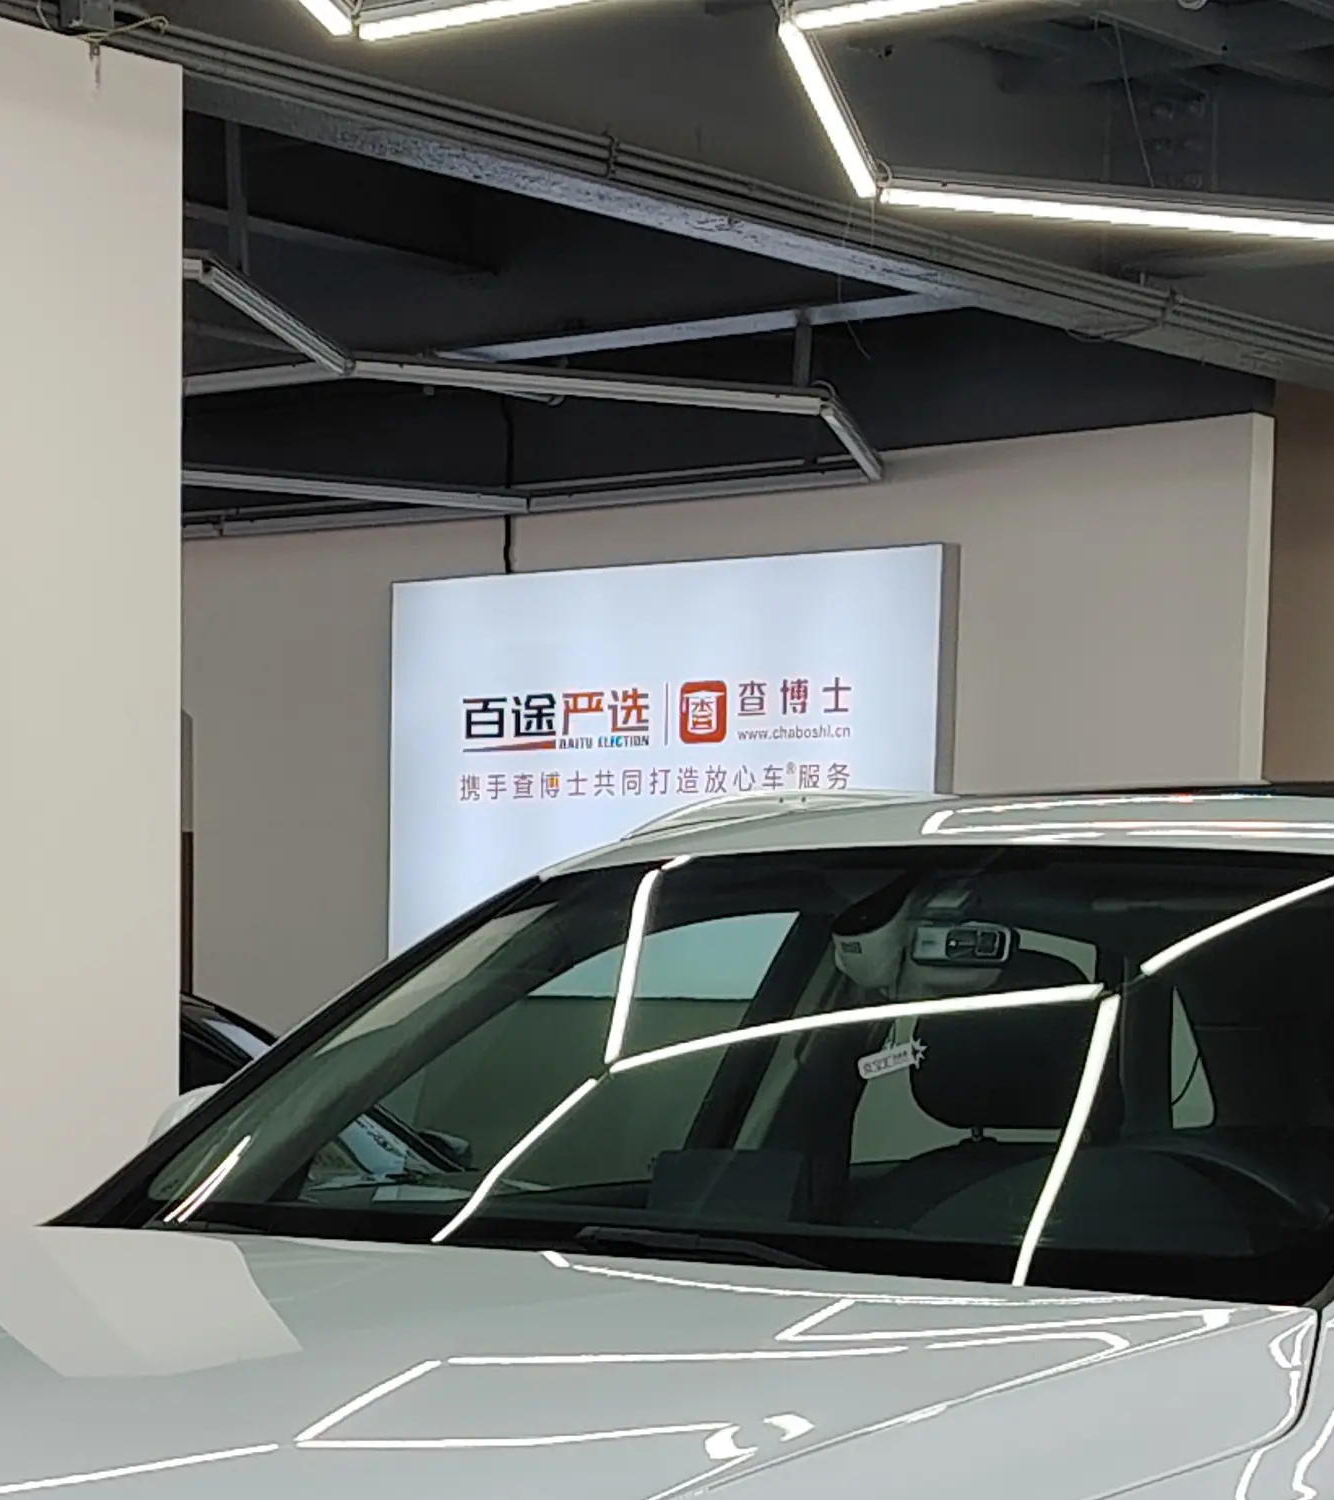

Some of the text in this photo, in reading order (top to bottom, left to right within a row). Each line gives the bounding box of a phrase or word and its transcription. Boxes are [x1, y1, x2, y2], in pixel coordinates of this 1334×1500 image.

[463, 687, 650, 739] 百途严选
[737, 676, 852, 717] 查博士
[736, 723, 851, 742] www.chaboshi.cn
